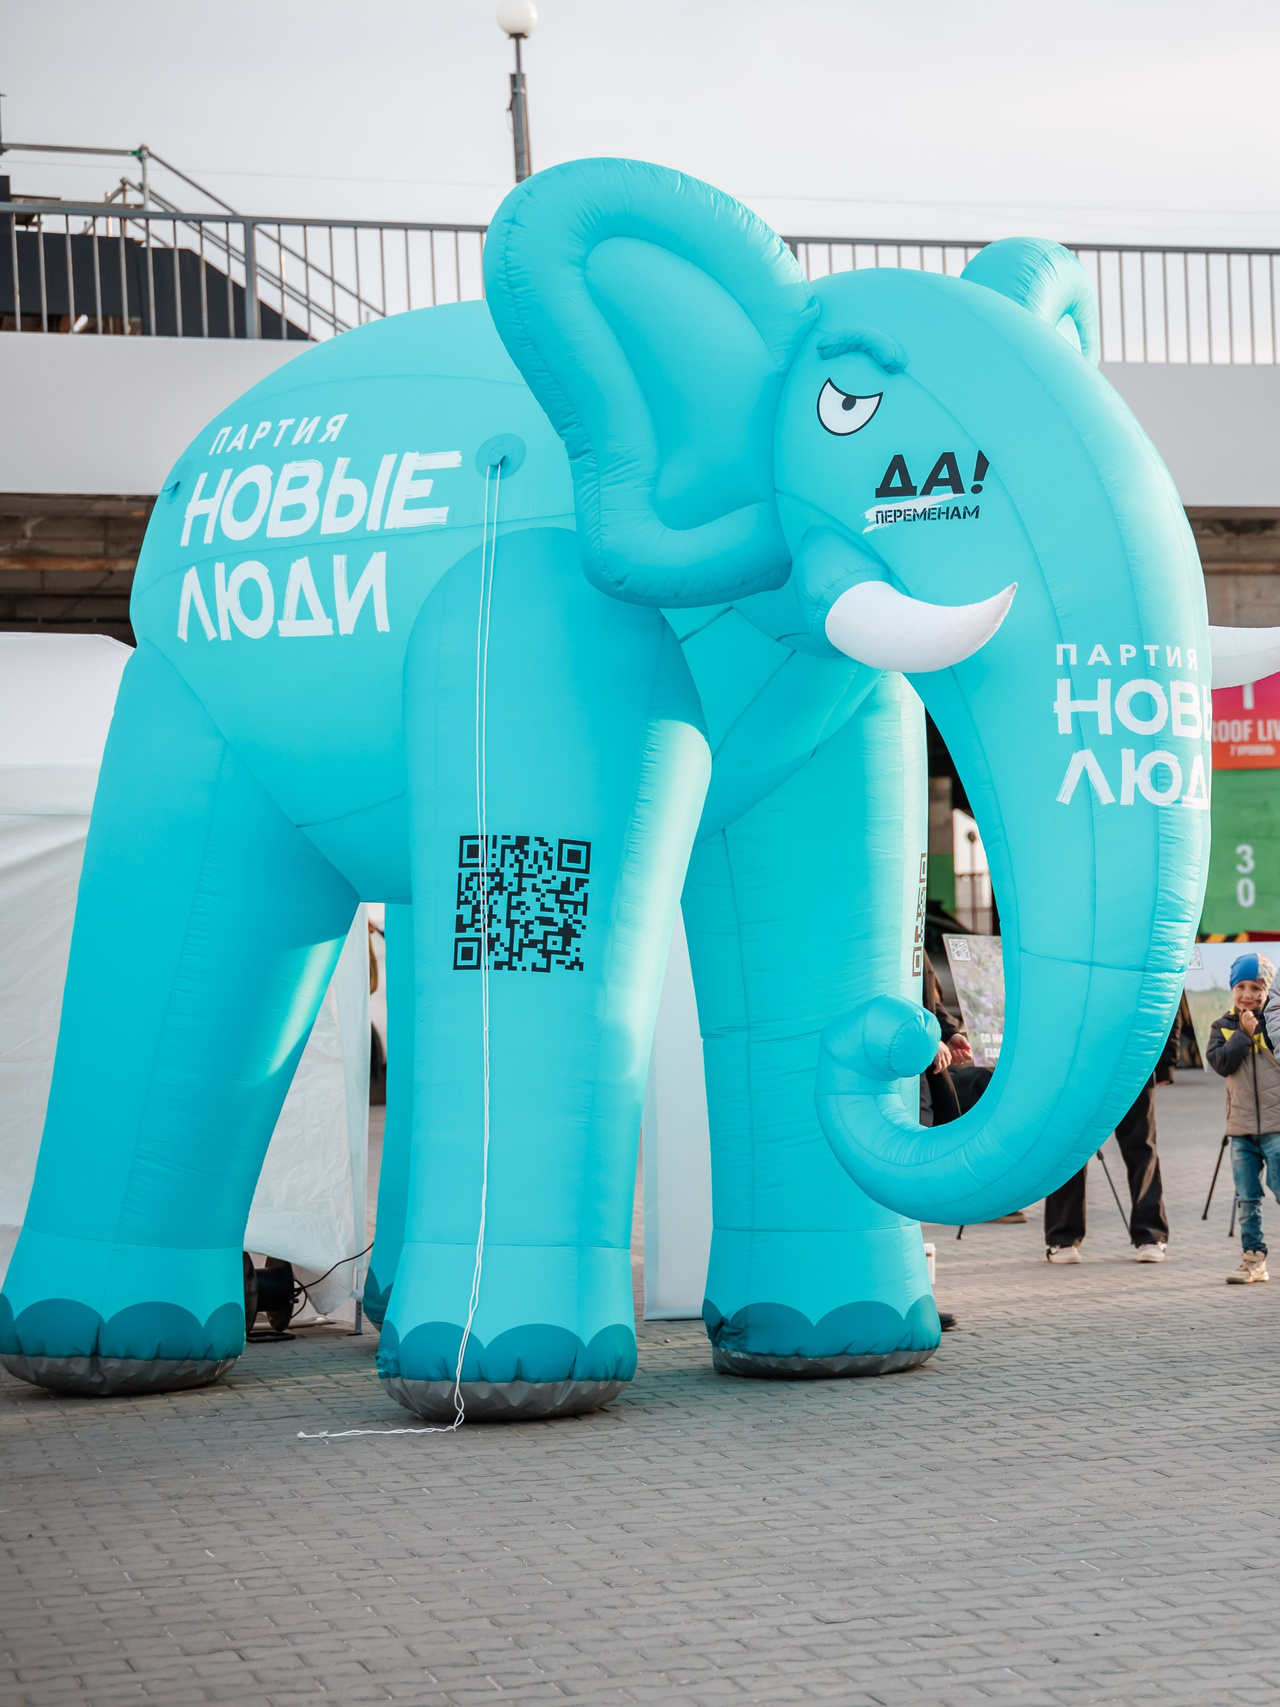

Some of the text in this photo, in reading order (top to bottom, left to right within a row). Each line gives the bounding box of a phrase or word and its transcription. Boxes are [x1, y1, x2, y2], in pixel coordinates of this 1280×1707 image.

[208, 413, 348, 456] ПАРТИЯ
[179, 450, 463, 547] НОВЫЕ
[875, 450, 990, 498] ДА!
[875, 505, 980, 525] ПЕРЕМЕНАМ
[177, 551, 391, 643] ЛЮДИ
[1056, 643, 1199, 671] ПАРТИЯ
[1053, 678, 1212, 741] НОВ
[1056, 748, 1211, 810] ЛЮД
